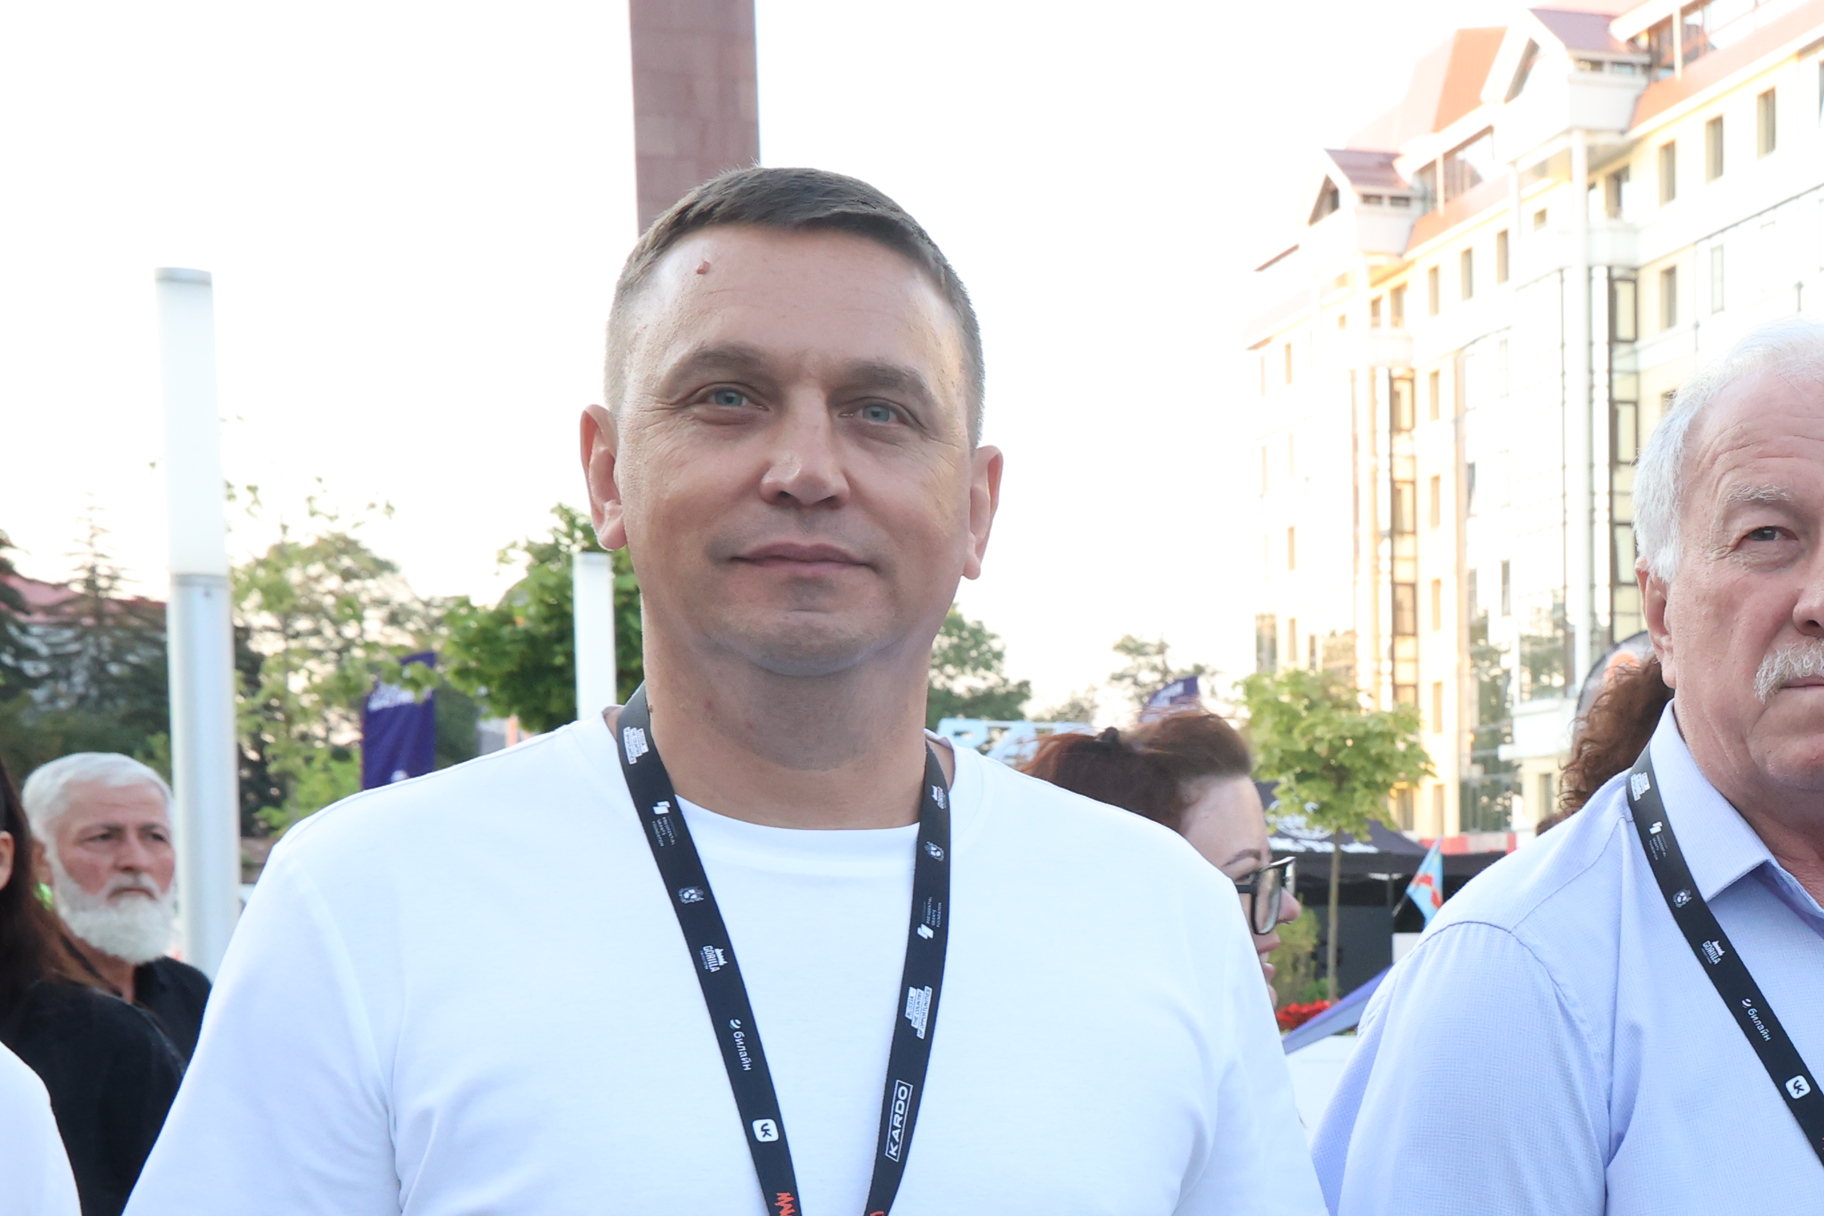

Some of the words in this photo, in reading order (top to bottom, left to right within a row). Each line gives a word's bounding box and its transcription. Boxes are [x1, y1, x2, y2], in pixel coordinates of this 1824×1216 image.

[702, 945, 720, 973] GORILLA
[1702, 940, 1721, 965] GORILLA
[1747, 1007, 1771, 1042] билайн
[733, 1030, 752, 1071] билайн
[888, 1085, 909, 1157] KARDO
